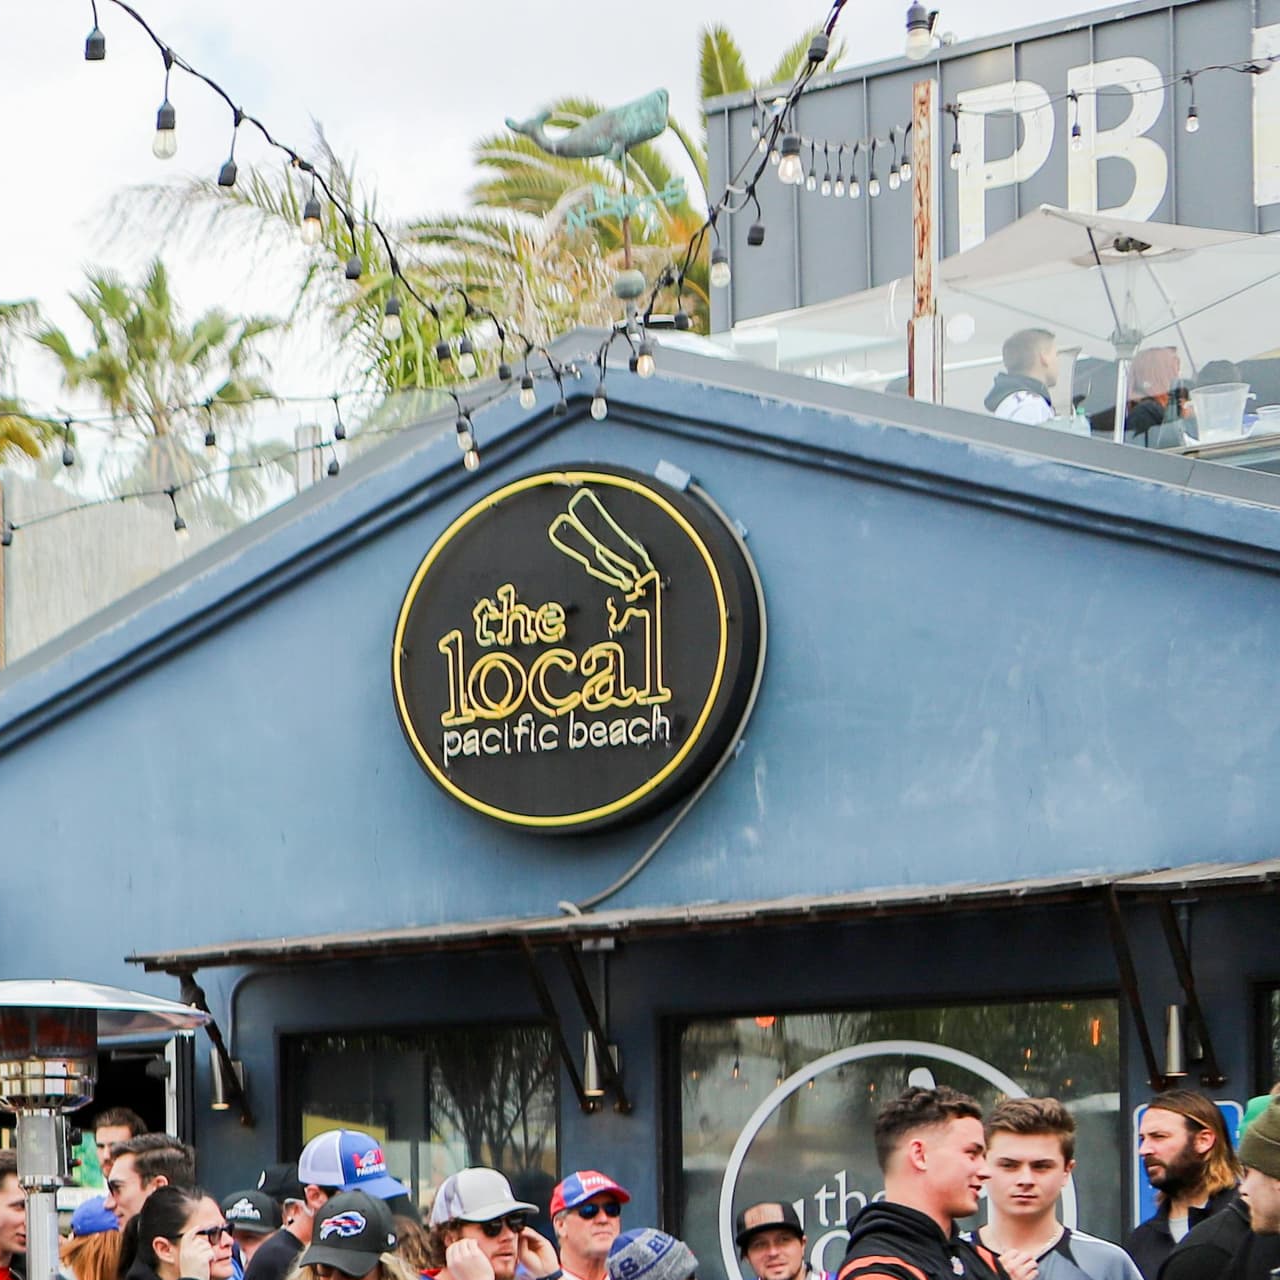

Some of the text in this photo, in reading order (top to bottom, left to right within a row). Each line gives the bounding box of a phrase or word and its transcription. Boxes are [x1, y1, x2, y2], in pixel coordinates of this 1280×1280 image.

[956, 56, 1168, 253] PB
[438, 570, 672, 727] local
[472, 582, 567, 646] the
[442, 703, 672, 767] pacific beach
